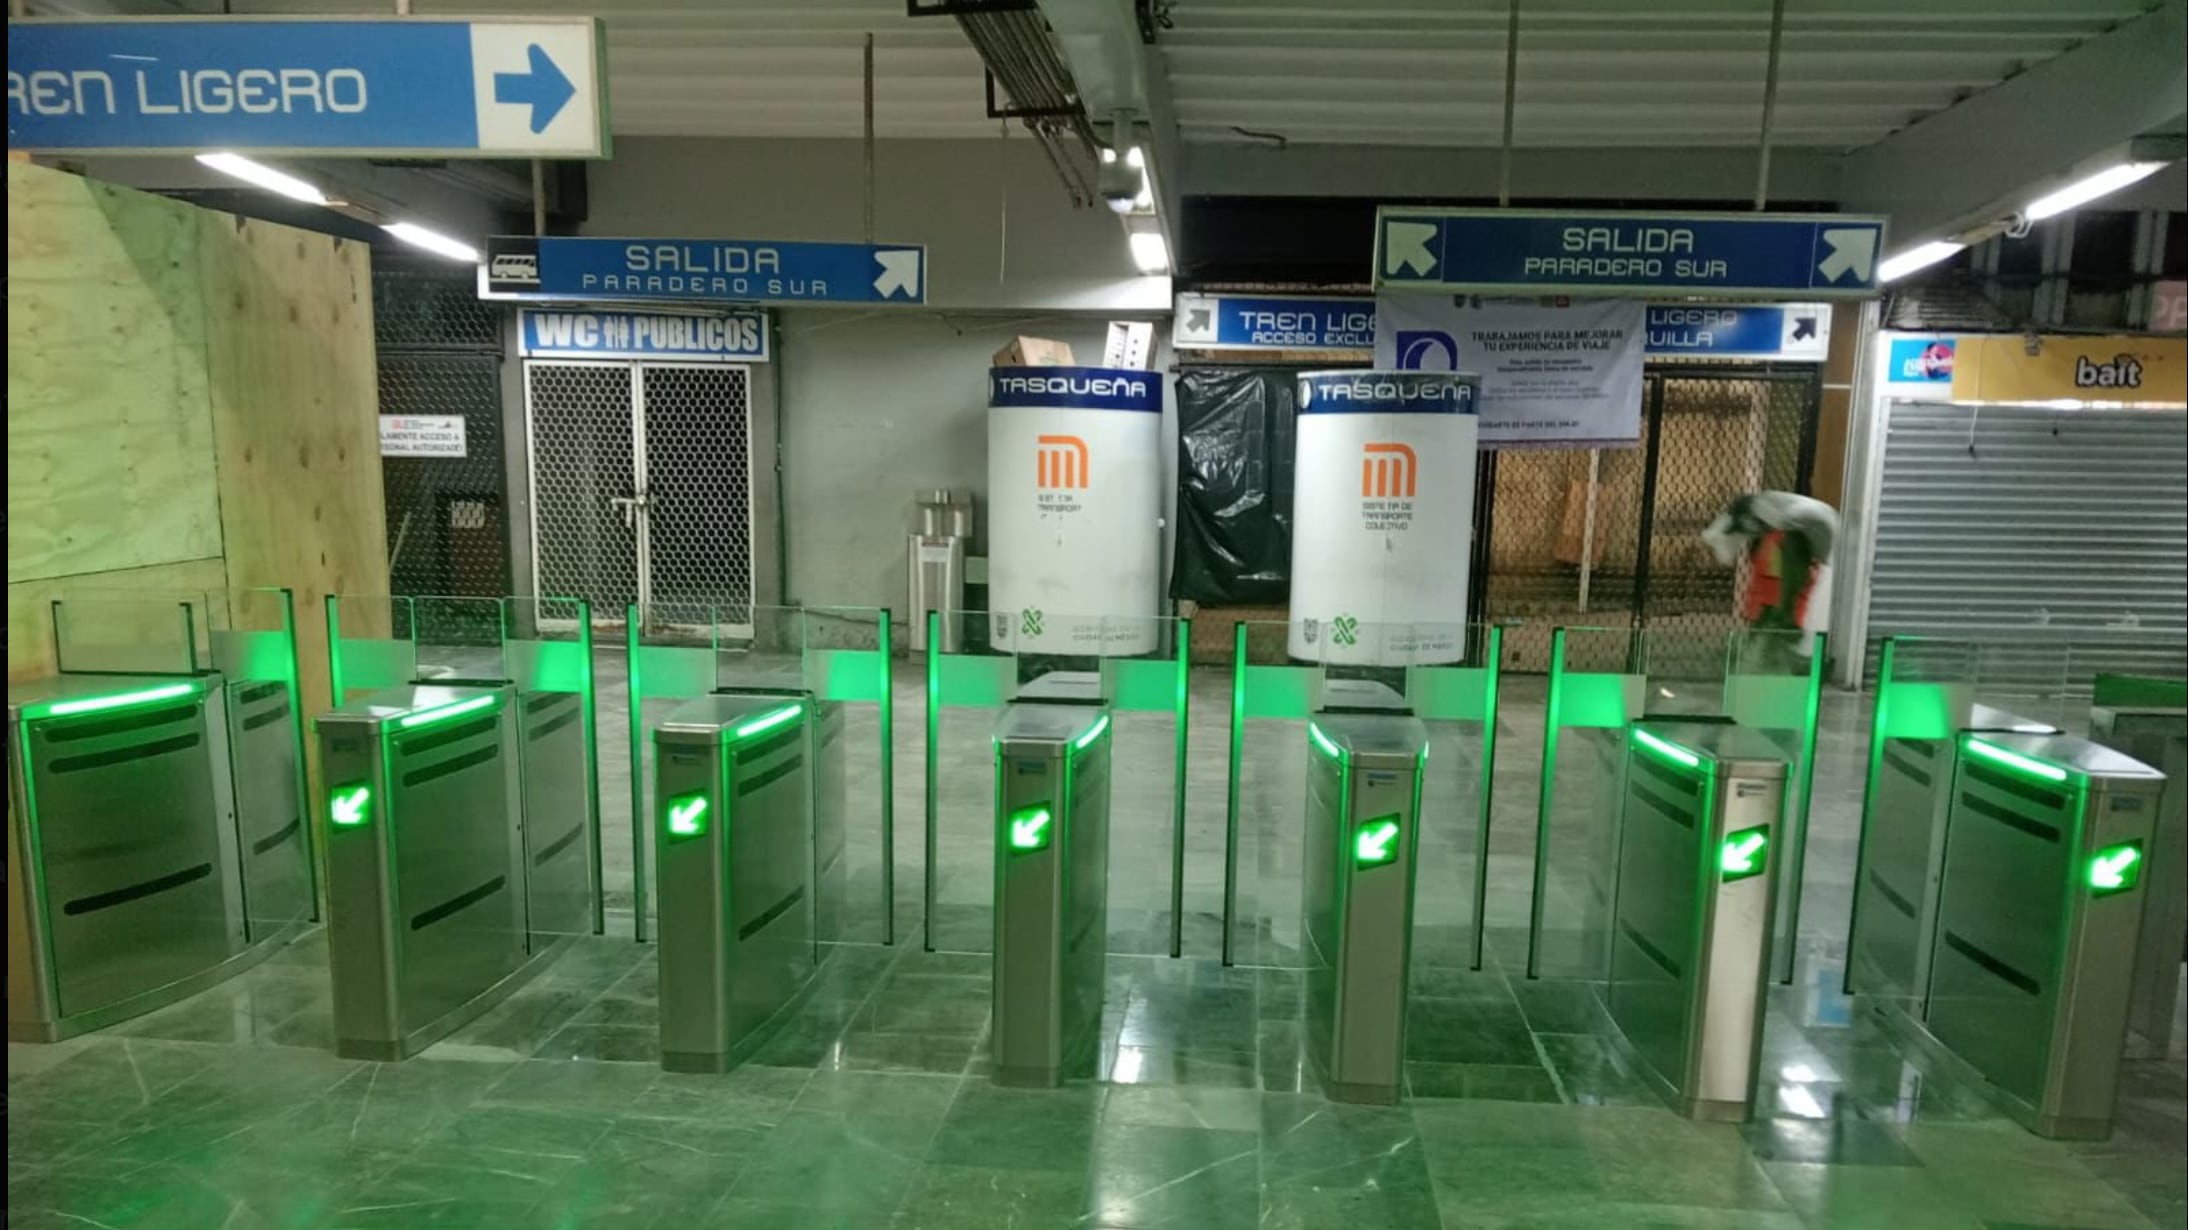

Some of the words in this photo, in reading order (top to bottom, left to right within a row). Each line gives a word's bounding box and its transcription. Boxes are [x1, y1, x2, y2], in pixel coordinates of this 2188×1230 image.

[136, 68, 368, 114] LIGERO
[1563, 227, 1695, 253] SALIDA
[625, 245, 780, 274] SALIDA
[1524, 257, 1662, 277] PARADERO
[1675, 259, 1728, 278] SUR
[582, 274, 748, 294] PARADERO
[768, 279, 828, 296] SUR
[1239, 311, 1316, 331] TREN
[1651, 309, 1738, 326] LIGERO
[534, 313, 599, 348] WC
[633, 314, 760, 351] PUBLICOS
[1252, 331, 1317, 345] ACCESO
[1472, 331, 1541, 341] TRABAJAMOS
[1543, 331, 1572, 341] PARA
[1574, 329, 1624, 340] MEJORAR
[1484, 341, 1496, 352] TU
[1498, 341, 1565, 352] EXPERIENCIA
[1567, 341, 1579, 351] DE
[1582, 340, 1610, 350] VIAJE
[2076, 354, 2142, 388] bait
[1000, 377, 1146, 398] TASQUEÑA
